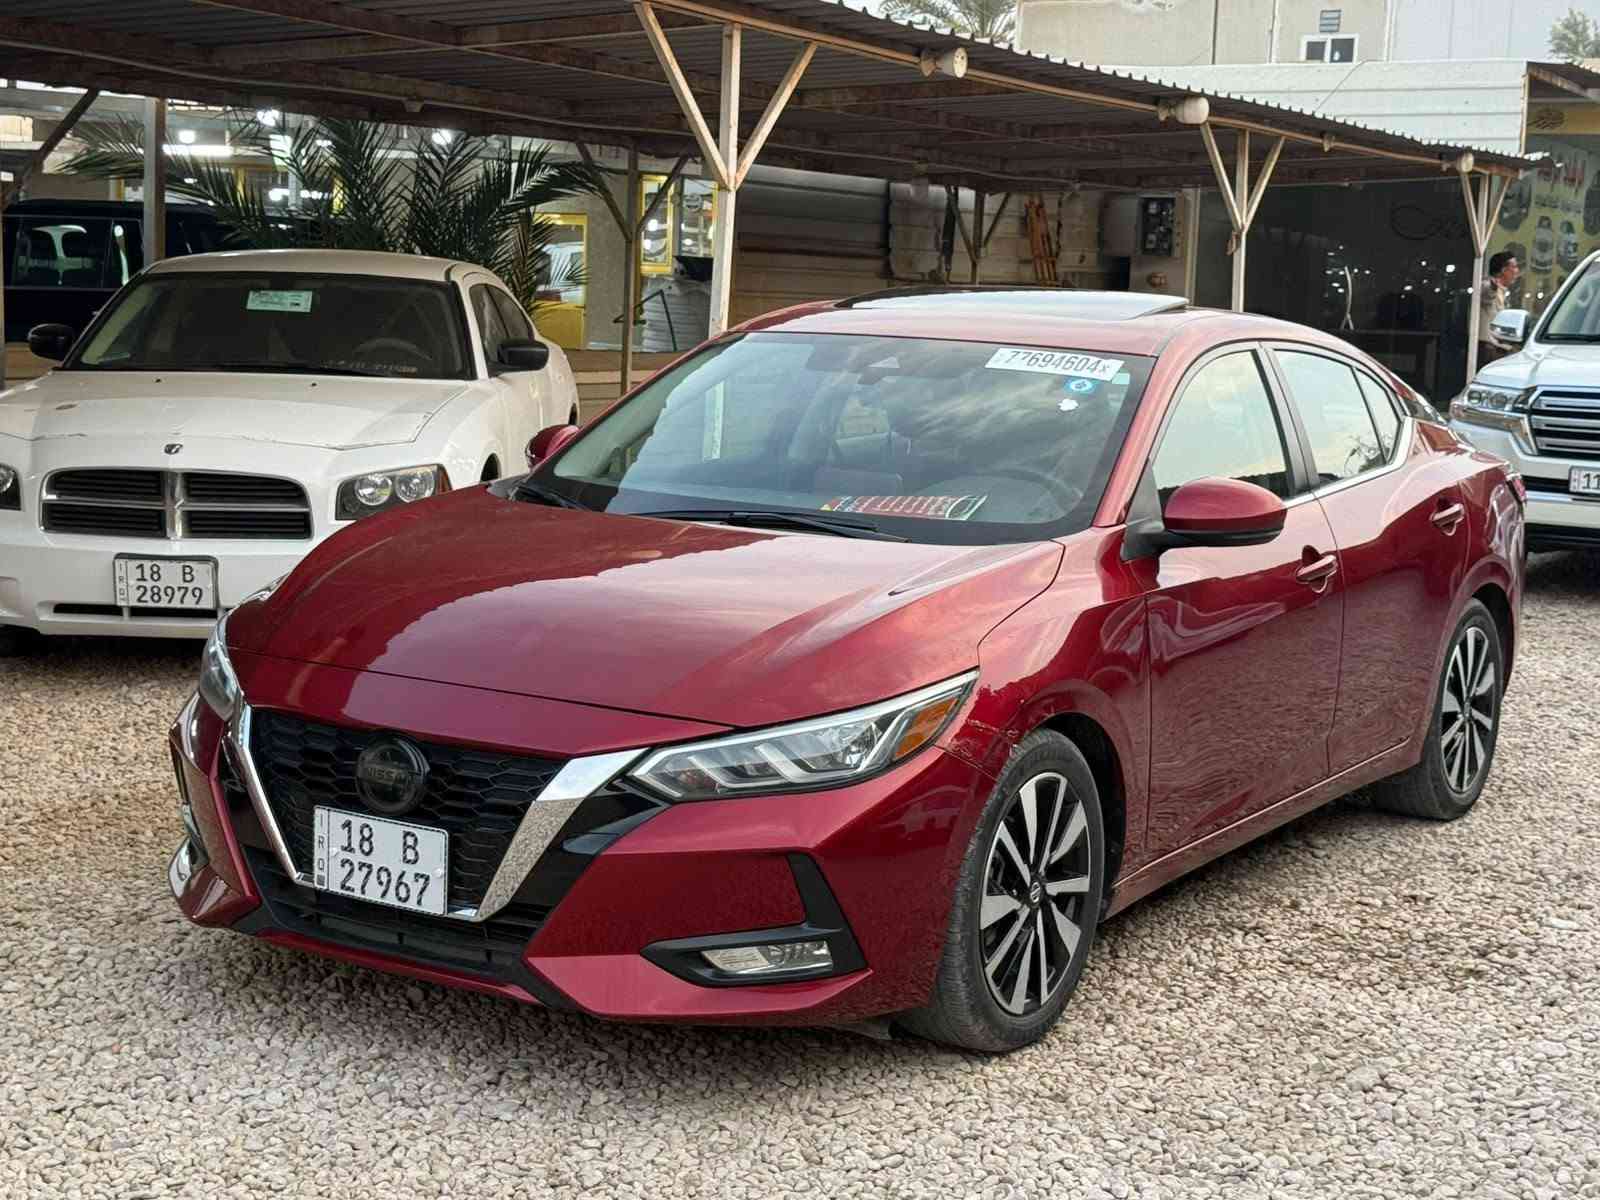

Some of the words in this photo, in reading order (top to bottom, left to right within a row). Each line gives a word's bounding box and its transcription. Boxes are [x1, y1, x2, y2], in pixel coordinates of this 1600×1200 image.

[135, 563, 161, 582] 18
[182, 564, 195, 583] B
[135, 584, 204, 605] 28979
[340, 819, 375, 857] 18
[401, 830, 420, 865] B
[339, 857, 431, 907] 27967
